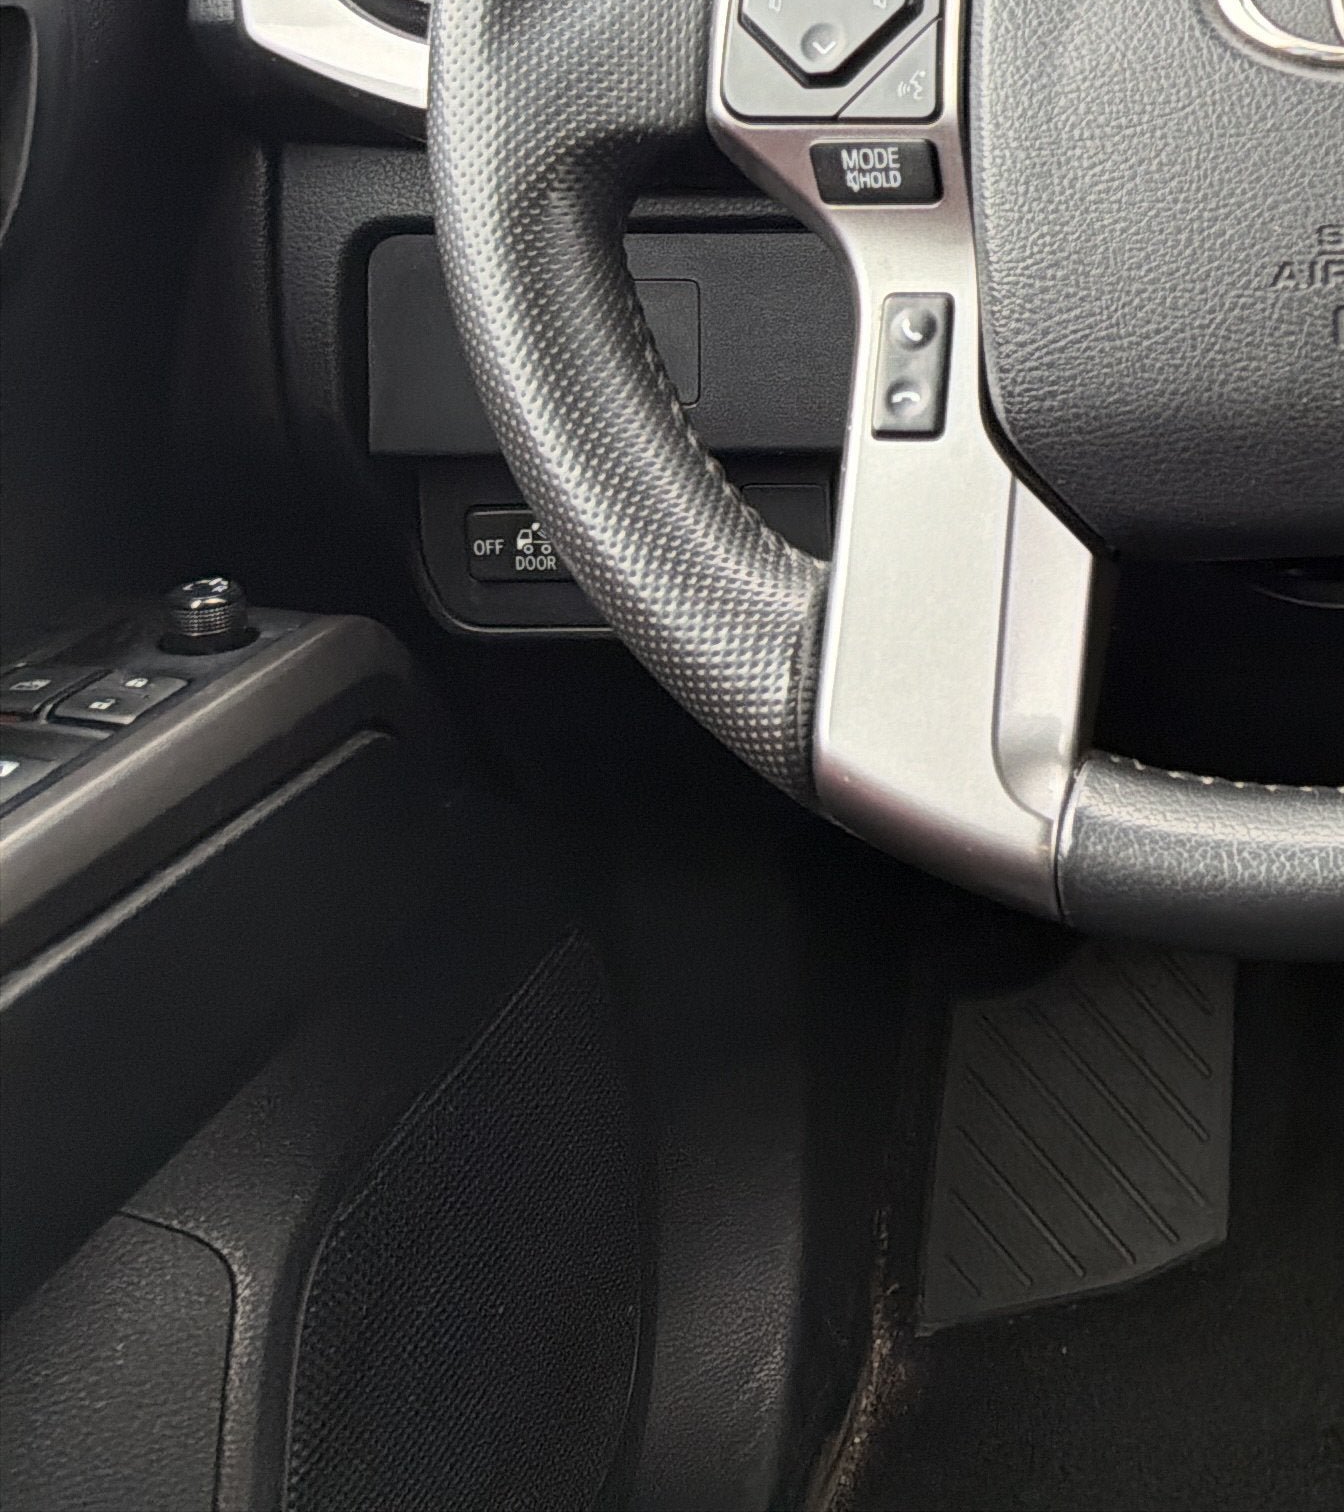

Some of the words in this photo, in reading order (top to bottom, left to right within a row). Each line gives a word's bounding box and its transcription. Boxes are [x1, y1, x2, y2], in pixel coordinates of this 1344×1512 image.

[841, 147, 901, 169] MODE
[860, 171, 902, 188] HOLD
[473, 539, 504, 556] OFF
[515, 555, 557, 571] DOOR
